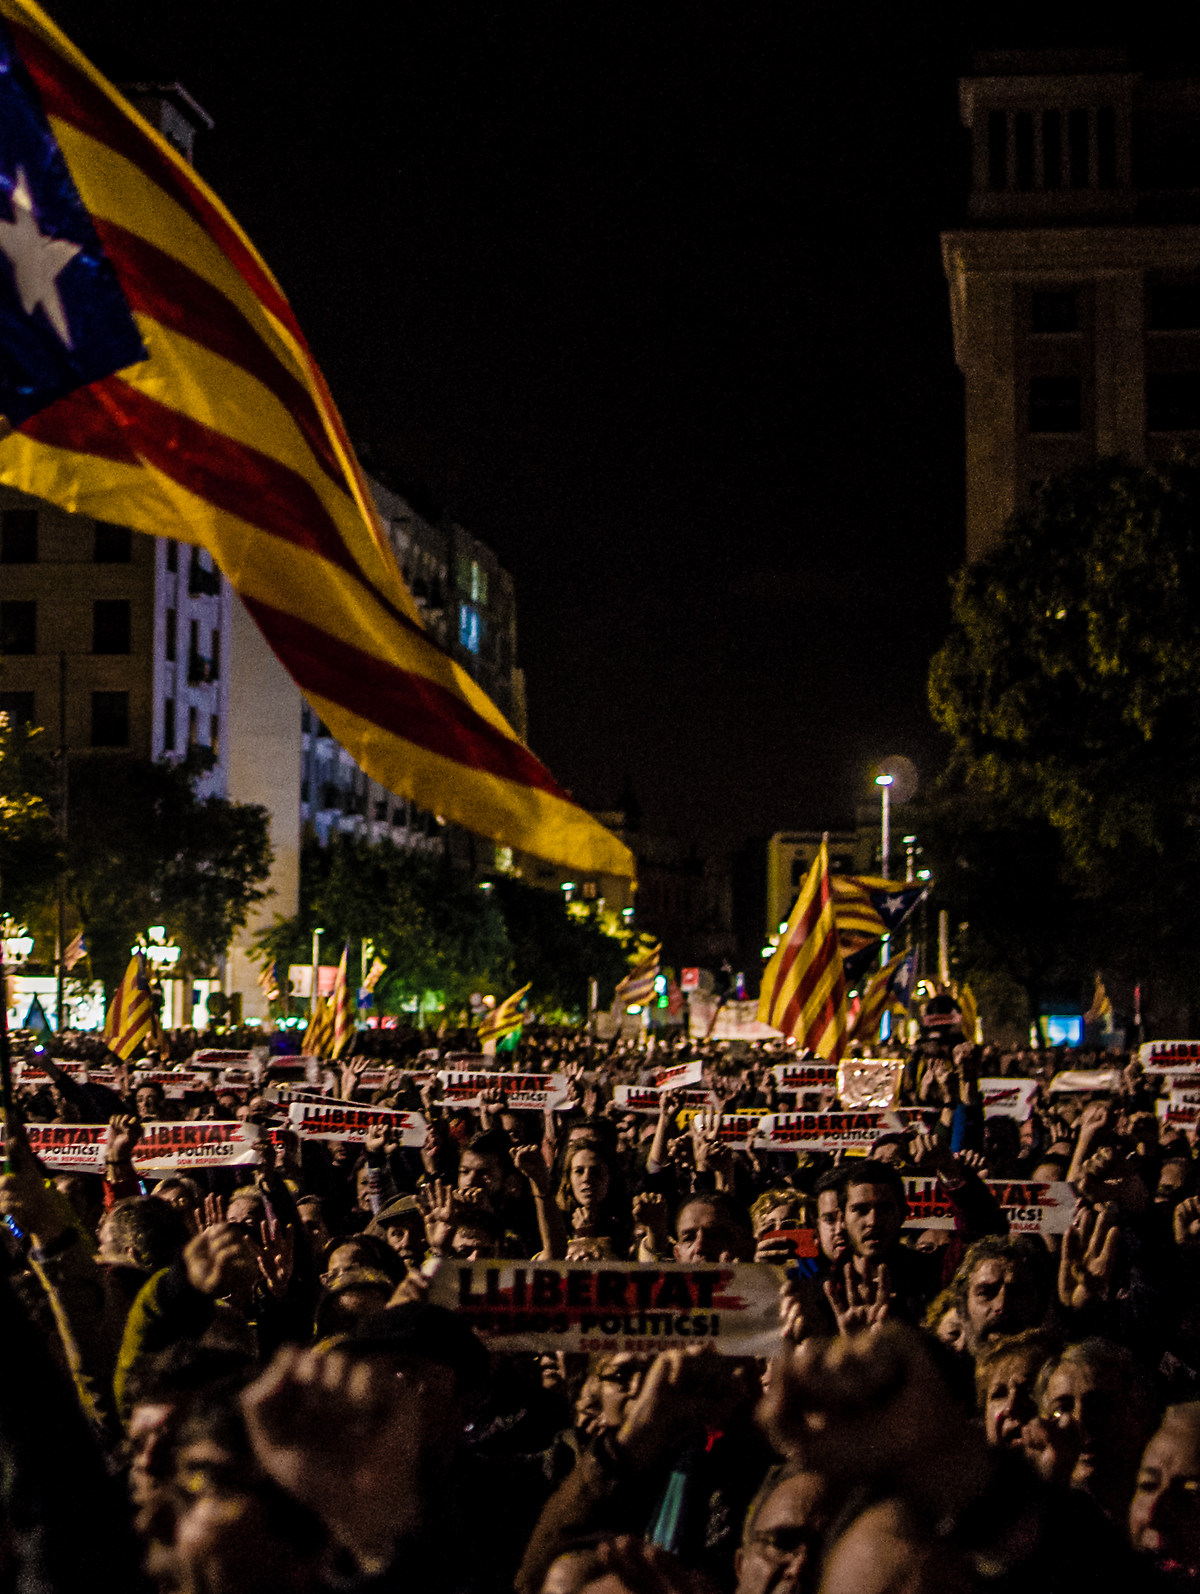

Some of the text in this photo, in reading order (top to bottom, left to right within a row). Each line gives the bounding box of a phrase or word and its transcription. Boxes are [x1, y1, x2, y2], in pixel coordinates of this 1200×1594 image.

[304, 1107, 405, 1128] LLIBERTAT
[773, 1113, 880, 1130] LLIBERTAT
[141, 1123, 237, 1145] LIBERTAT
[458, 1267, 721, 1308] LLIBERTAT
